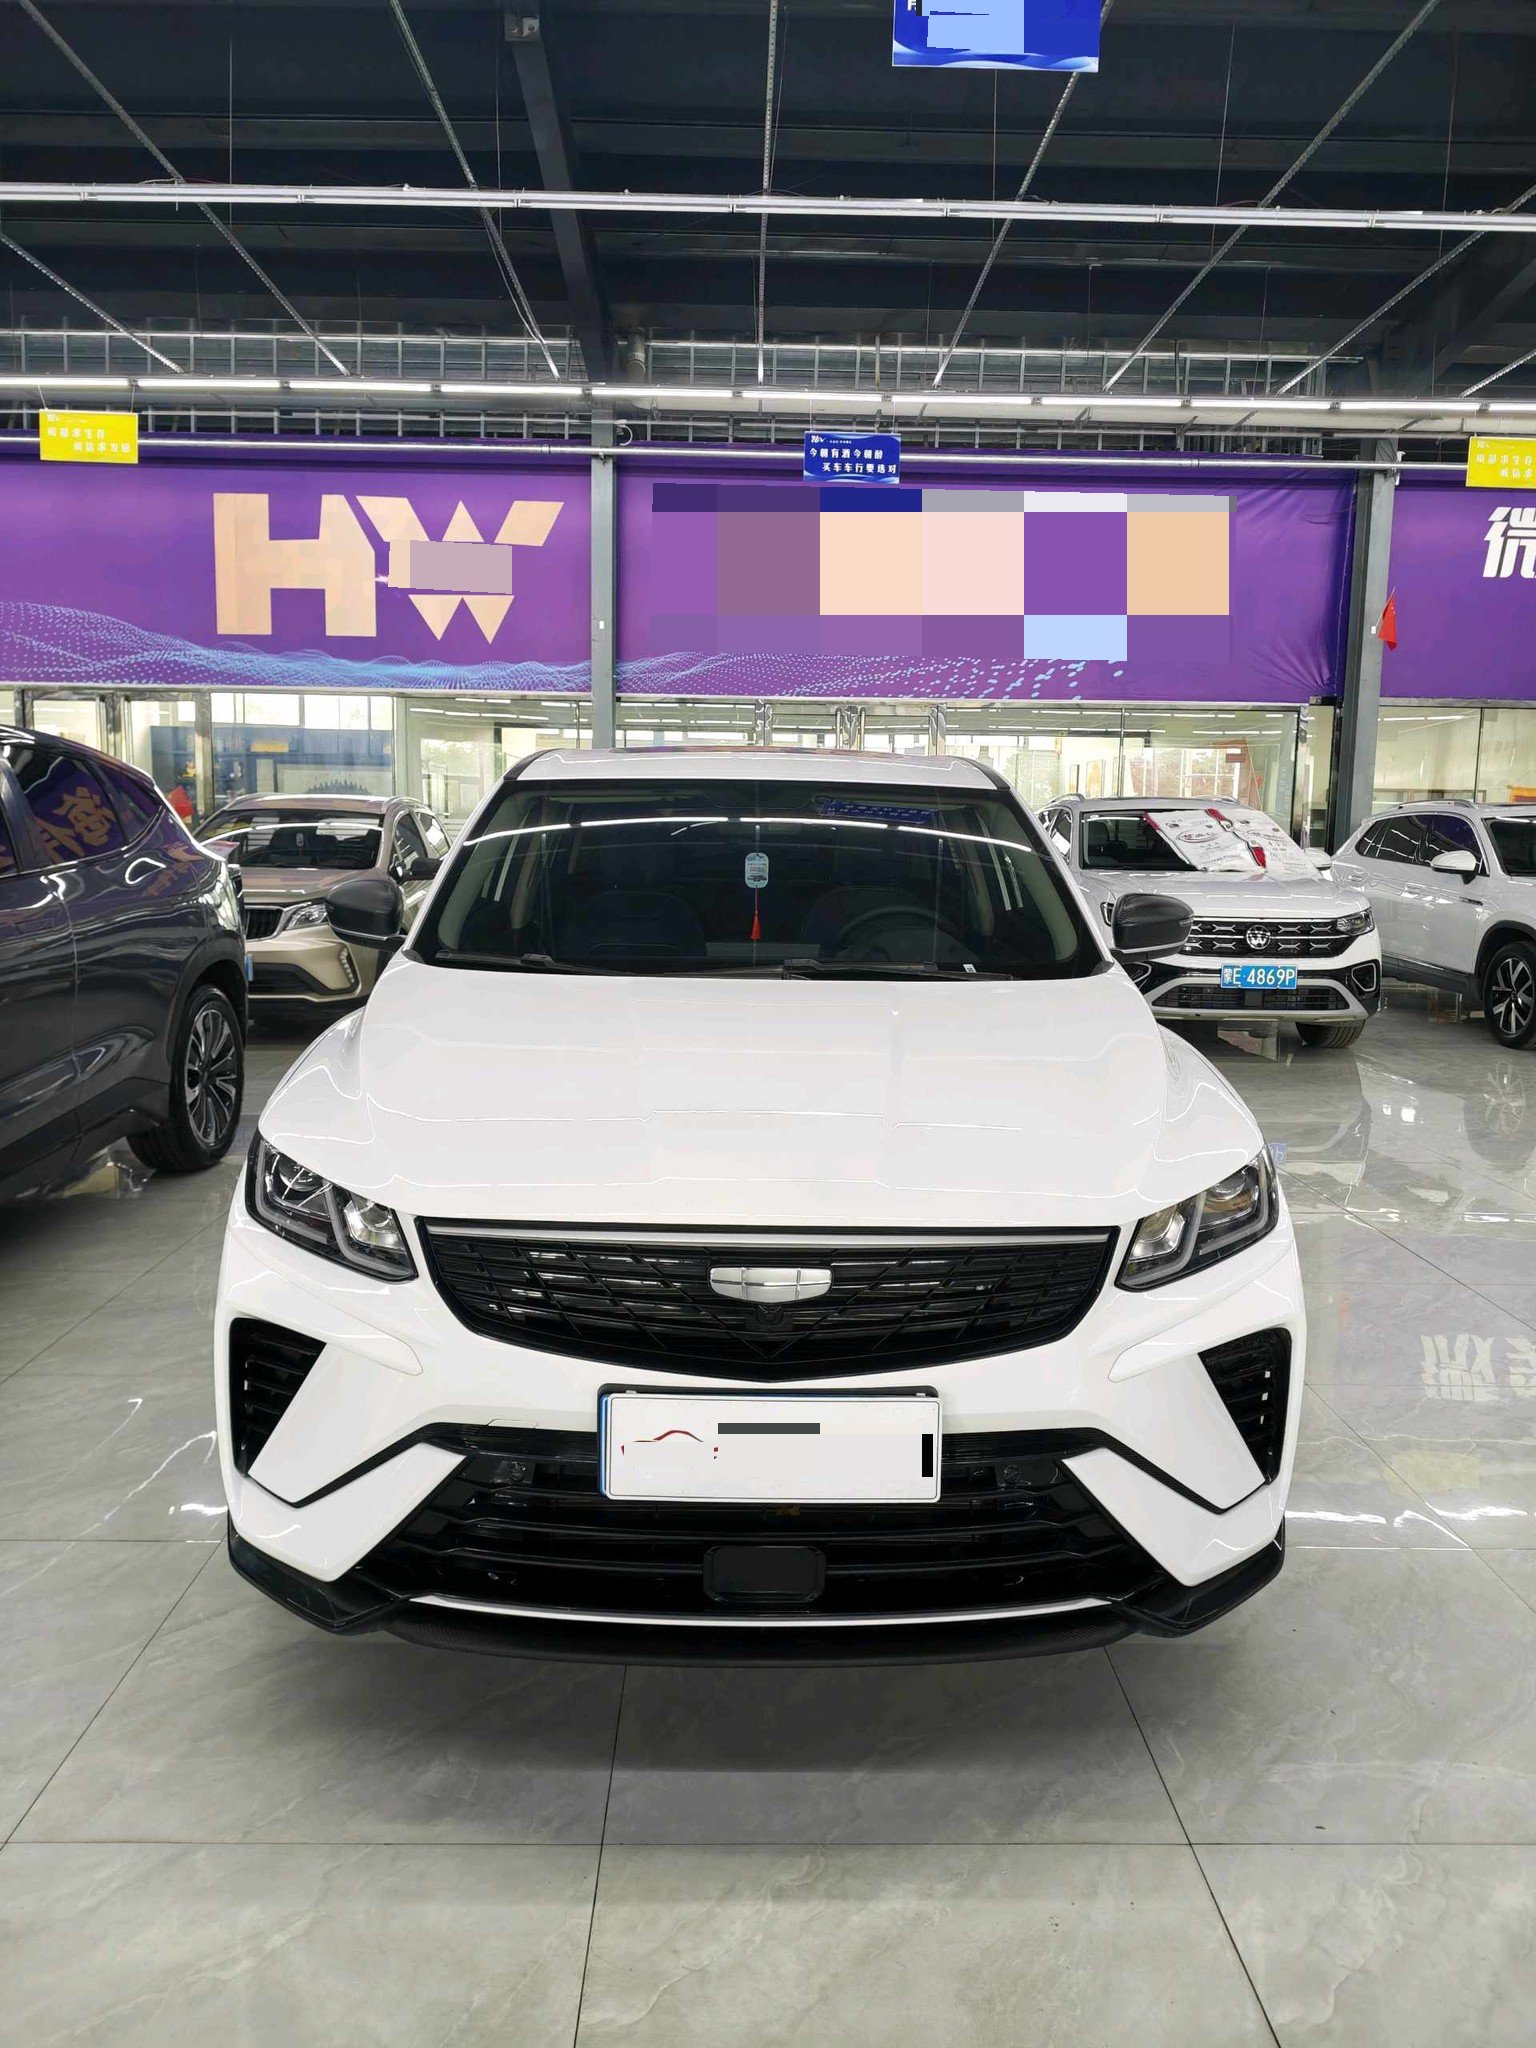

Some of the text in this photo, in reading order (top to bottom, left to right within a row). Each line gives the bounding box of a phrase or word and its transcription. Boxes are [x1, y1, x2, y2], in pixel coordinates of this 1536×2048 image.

[822, 462, 897, 474] 买车车行要选对
